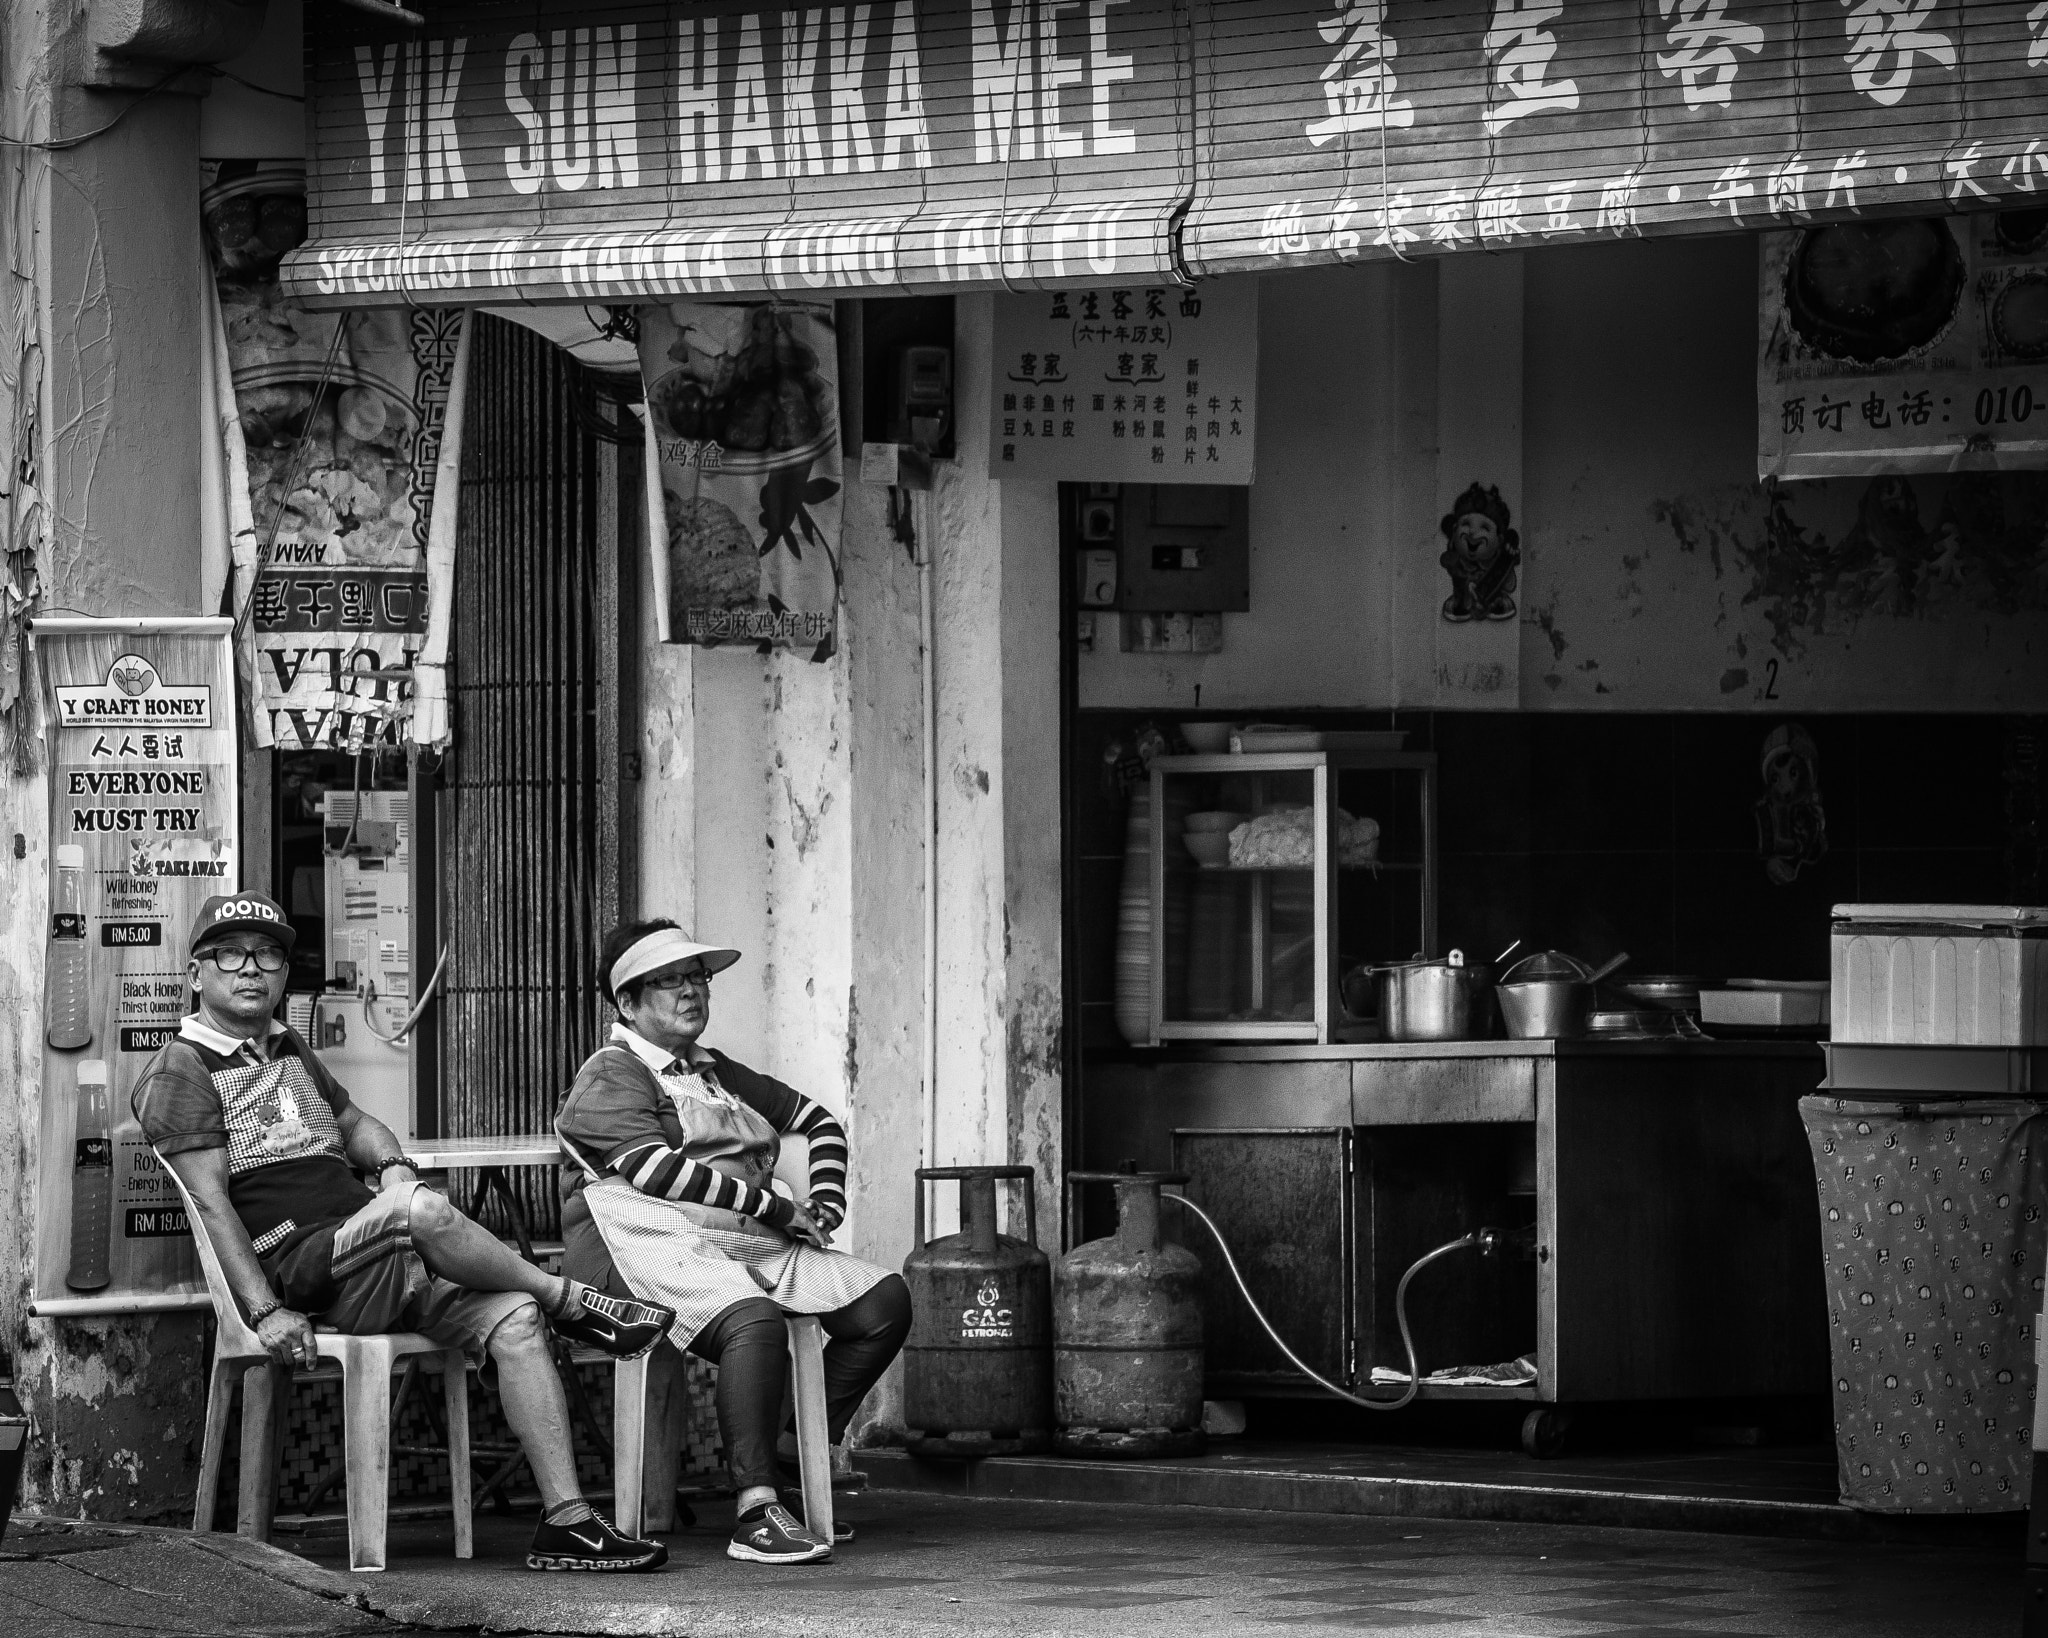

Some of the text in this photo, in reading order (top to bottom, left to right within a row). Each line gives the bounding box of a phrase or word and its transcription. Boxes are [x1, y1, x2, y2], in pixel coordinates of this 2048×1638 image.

[1306, 0, 2048, 145] 益生客家
[354, 0, 1137, 205] YIK SUN HAKKA MEE
[560, 226, 740, 297] HAKKA
[1052, 201, 1135, 277] FU
[1050, 289, 1201, 320] 益生客家面
[1021, 352, 1061, 377] 客家
[1117, 352, 1158, 377] 客家
[1092, 393, 1105, 412] 面
[1112, 394, 1127, 438] 米粉
[1132, 394, 1146, 438] 河粉
[275, 544, 327, 563] AYAM
[1764, 657, 1779, 700] 2
[63, 699, 205, 715] Y CRAFT HONEY
[91, 734, 184, 760] 人人要试
[68, 771, 203, 795] EVERYONE
[73, 808, 200, 832] MUST TRY
[155, 860, 228, 876] TAKE AWAY
[106, 879, 158, 896] Wild Honey
[112, 897, 152, 911] Refreshing
[112, 926, 151, 943] RM 5.00
[123, 981, 183, 999] Black Honey
[122, 1001, 184, 1014] Thirst Quencher
[132, 1031, 149, 1048] RM
[128, 1176, 160, 1193] Energy
[135, 1212, 189, 1232] RM 19.00
[962, 1308, 1013, 1327] GAS
